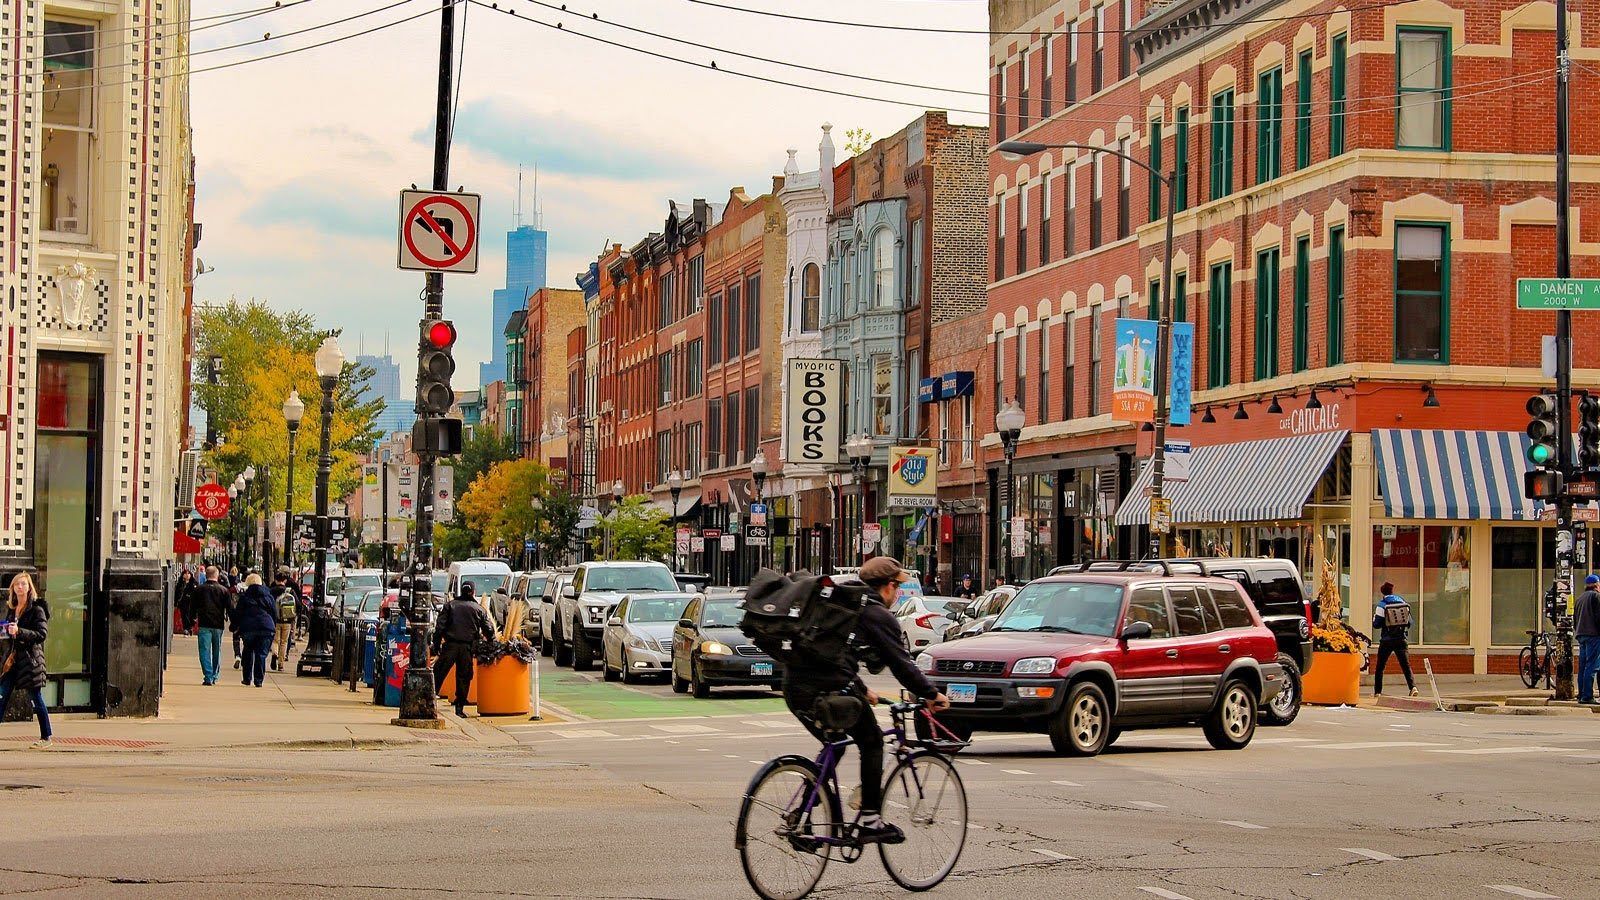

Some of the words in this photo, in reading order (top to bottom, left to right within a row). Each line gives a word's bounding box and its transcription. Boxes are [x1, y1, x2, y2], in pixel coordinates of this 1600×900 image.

[1524, 285, 1531, 293] N
[1540, 283, 1583, 295] DAMEN
[1544, 297, 1567, 305] 2000
[1573, 297, 1580, 305] W
[795, 362, 835, 370] MYOPIC
[1172, 333, 1190, 412] WELCOME
[1121, 400, 1131, 410] SSA
[802, 371, 827, 459] BOOKS
[1291, 403, 1340, 435] CANCALE
[906, 459, 922, 470] Old
[902, 468, 925, 484] Style
[894, 497, 903, 505] THE
[904, 497, 918, 506] REVEL
[919, 498, 933, 506] ROOM
